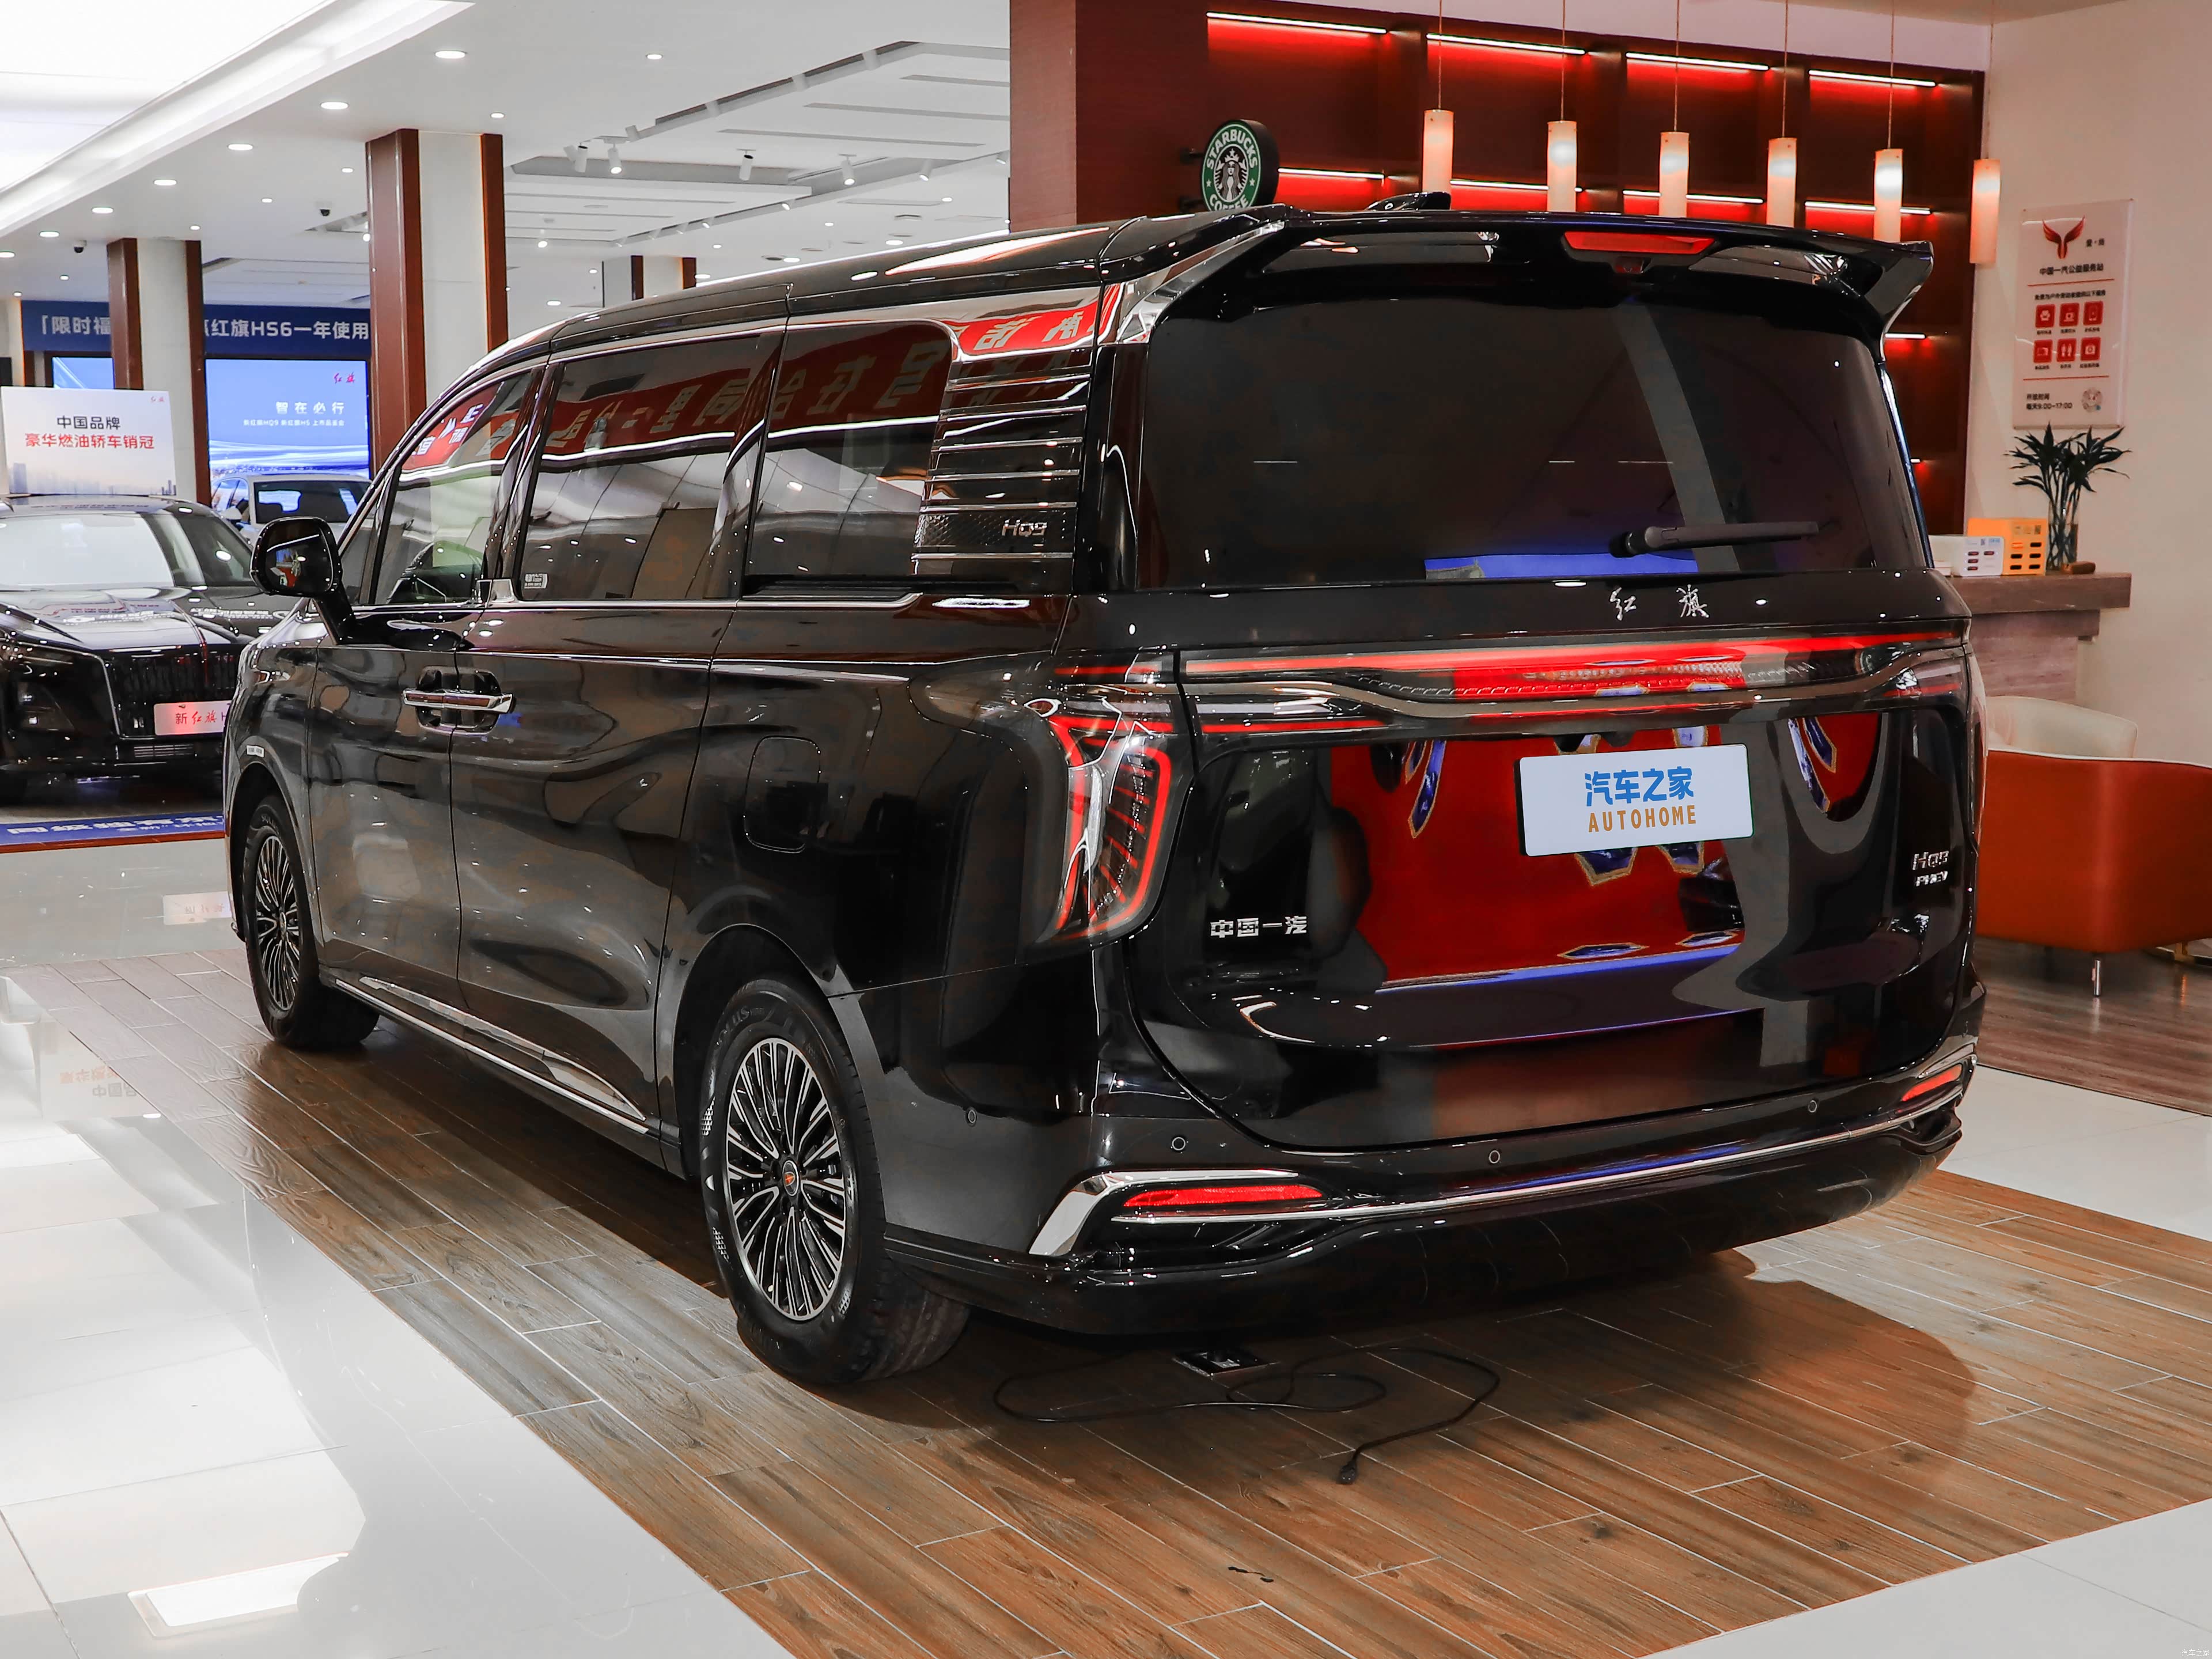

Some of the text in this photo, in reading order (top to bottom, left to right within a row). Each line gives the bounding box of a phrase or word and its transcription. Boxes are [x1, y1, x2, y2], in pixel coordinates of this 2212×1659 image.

[1206, 129, 1258, 169] STARBUCKS
[275, 402, 344, 414] 智在必行
[56, 415, 120, 430] 中国品牌
[25, 433, 154, 449] 豪华燃油轿车销冠
[1609, 584, 1710, 621] 红旗
[1585, 766, 1694, 806] 汽车之家
[1588, 805, 1696, 832] AUTOHOME
[1210, 915, 1307, 938] 中国一汽
